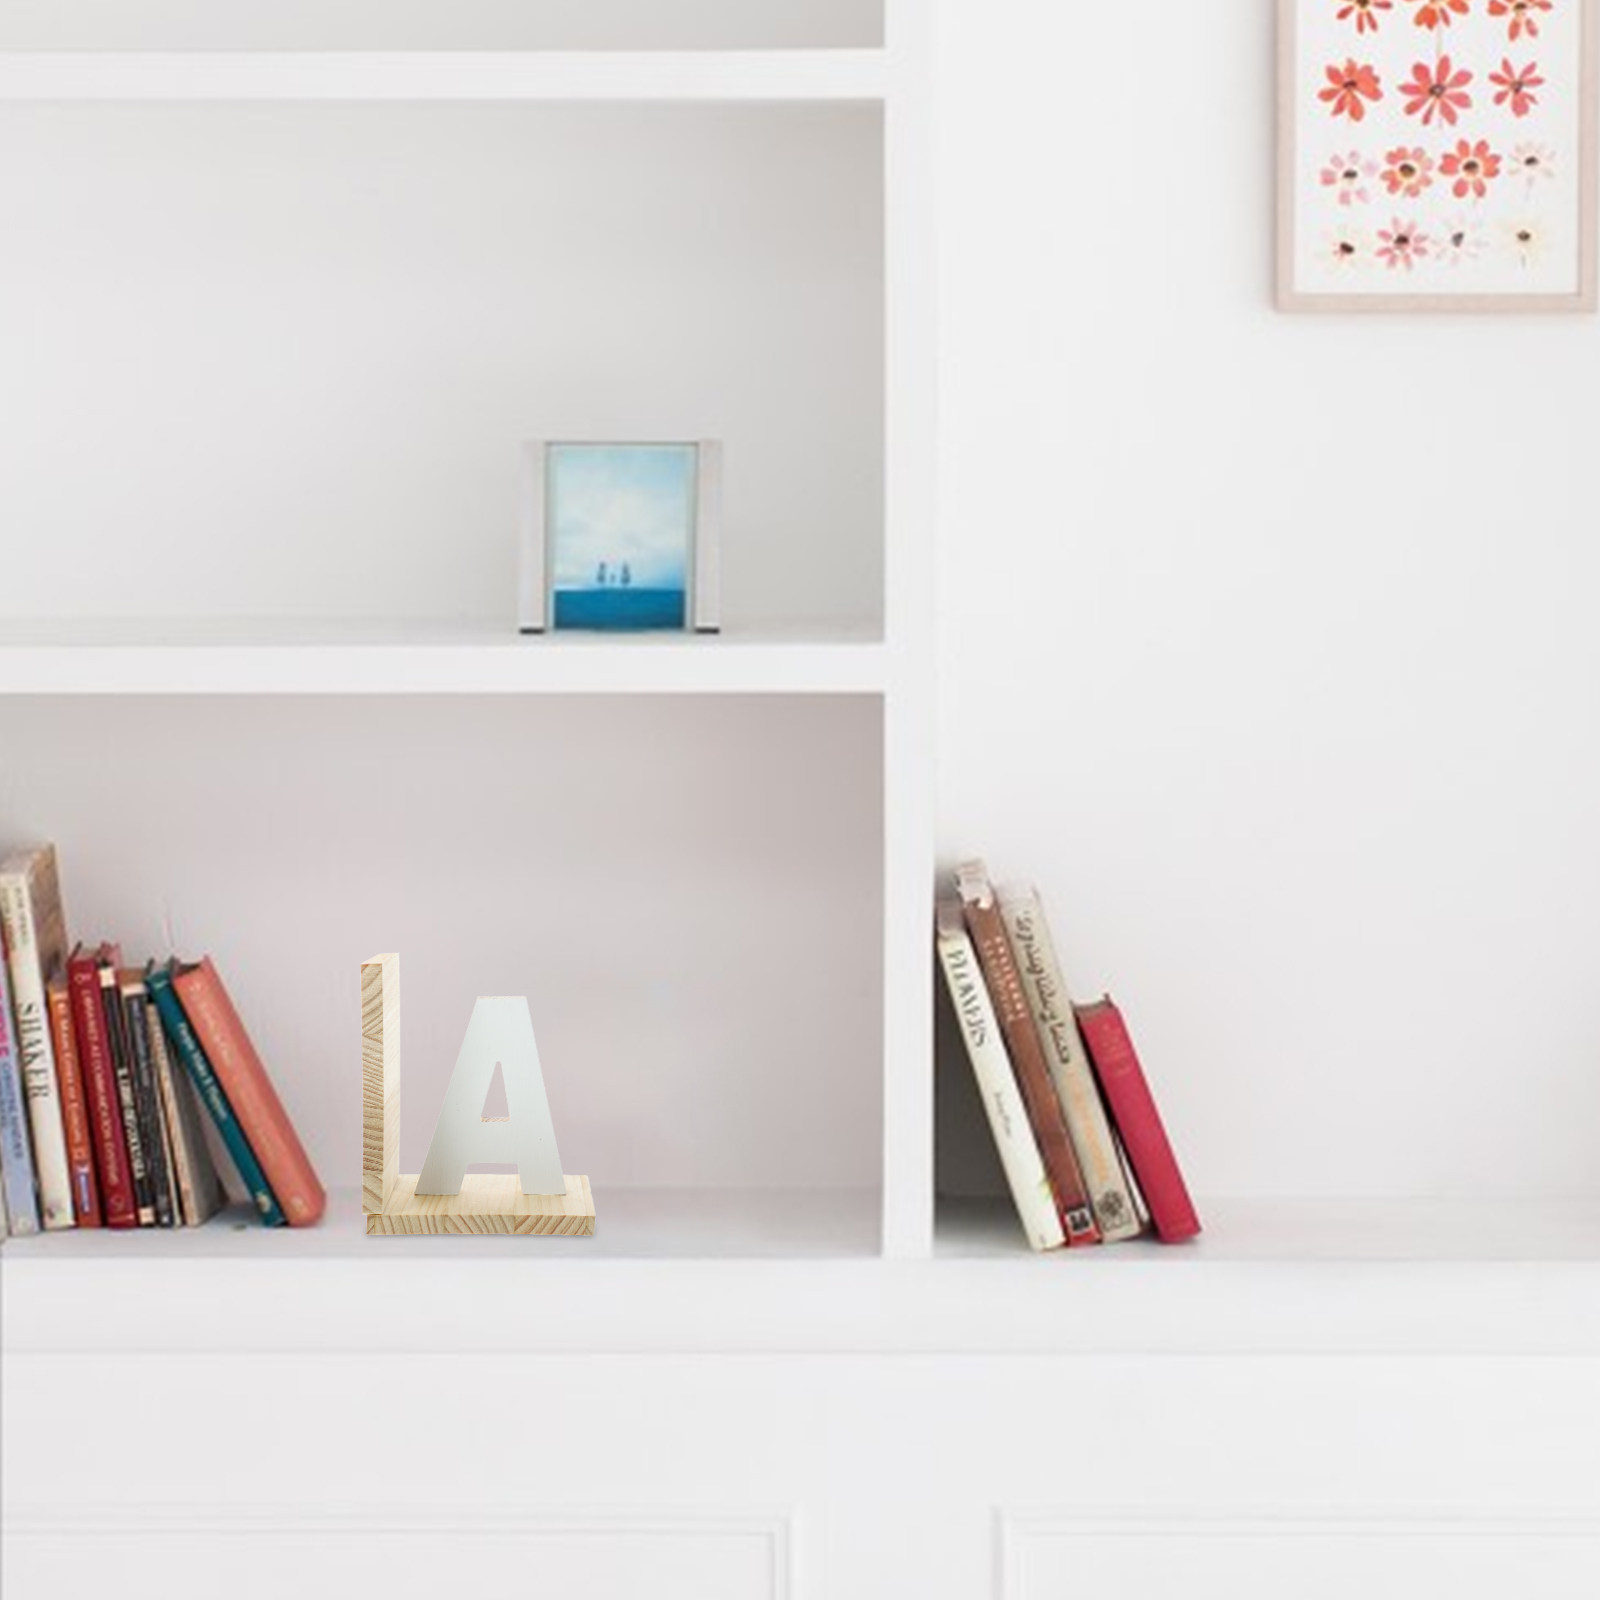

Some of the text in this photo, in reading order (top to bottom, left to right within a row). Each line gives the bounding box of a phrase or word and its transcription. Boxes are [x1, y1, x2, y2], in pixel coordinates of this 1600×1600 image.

[946, 949, 987, 1048] FLOWERS
[18, 1001, 51, 1099] SHAKER
[414, 996, 567, 1195] A
